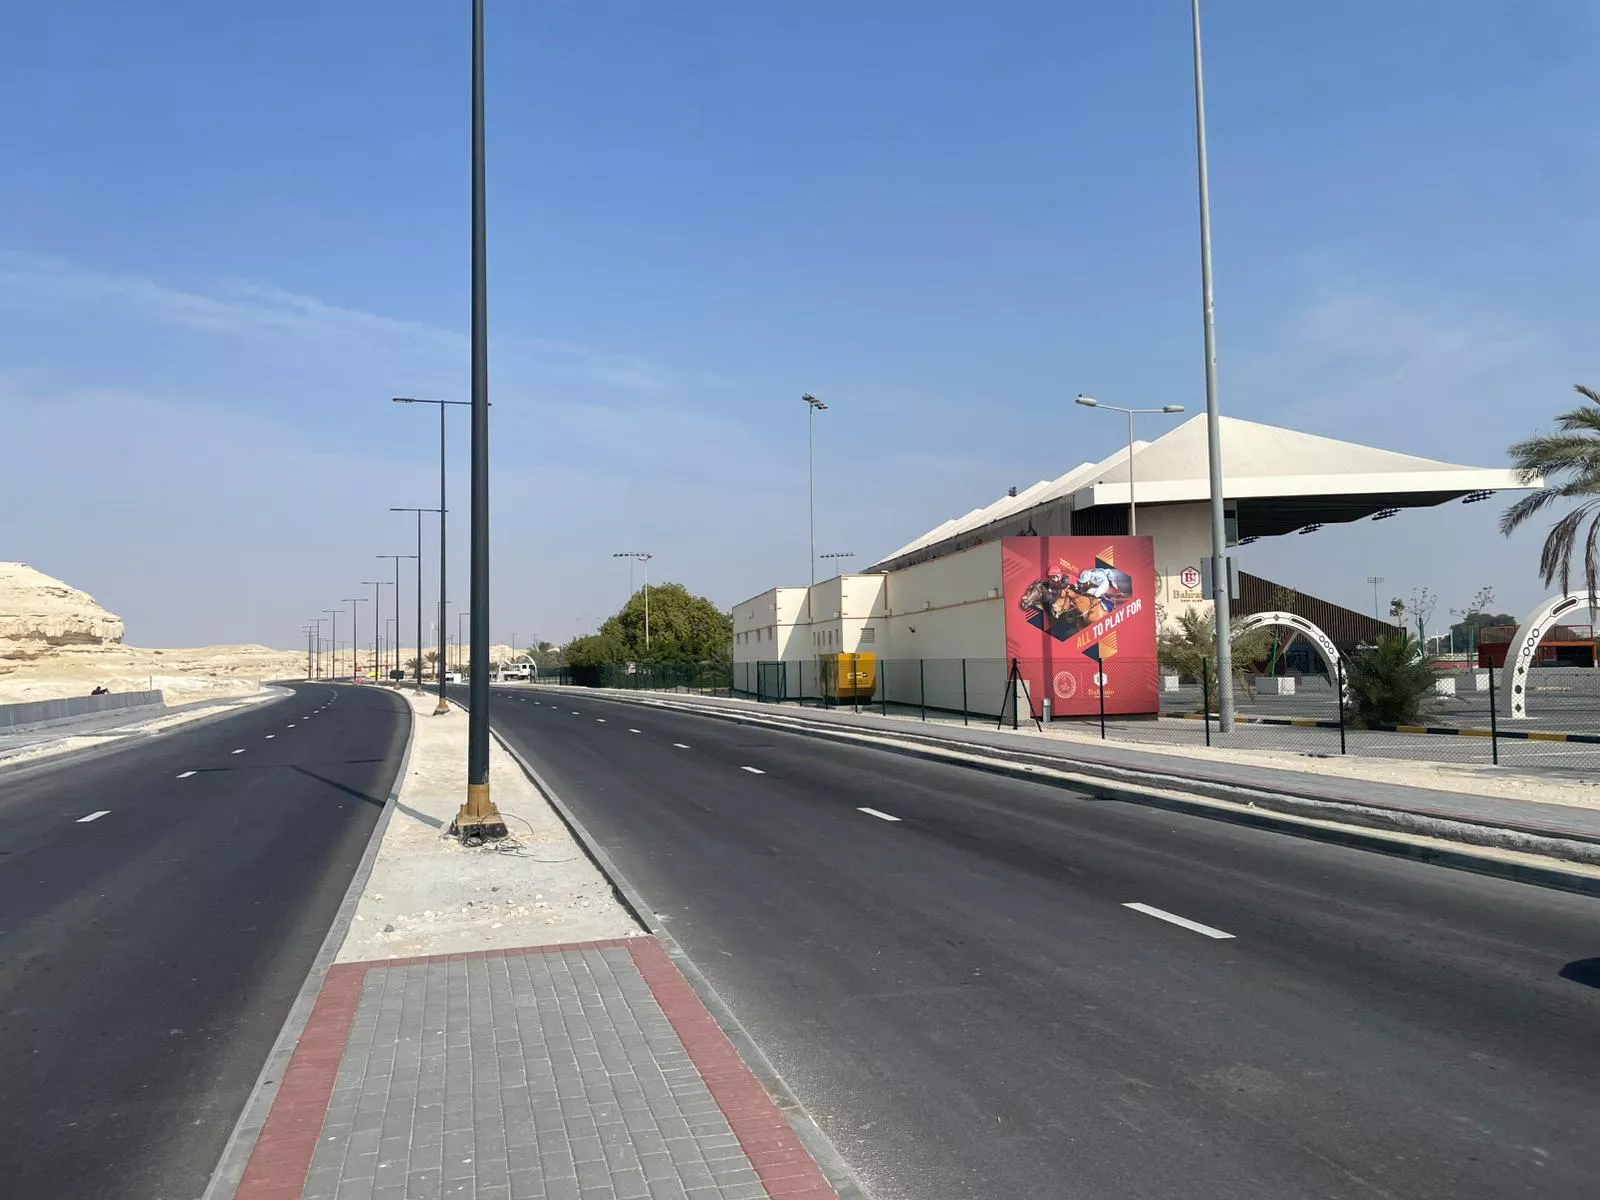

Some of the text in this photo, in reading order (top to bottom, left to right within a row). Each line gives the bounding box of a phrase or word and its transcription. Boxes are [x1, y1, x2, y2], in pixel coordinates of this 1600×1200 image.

[1173, 590, 1202, 599] Bahra
[1077, 598, 1142, 650] ALL TO PLAY FOR
